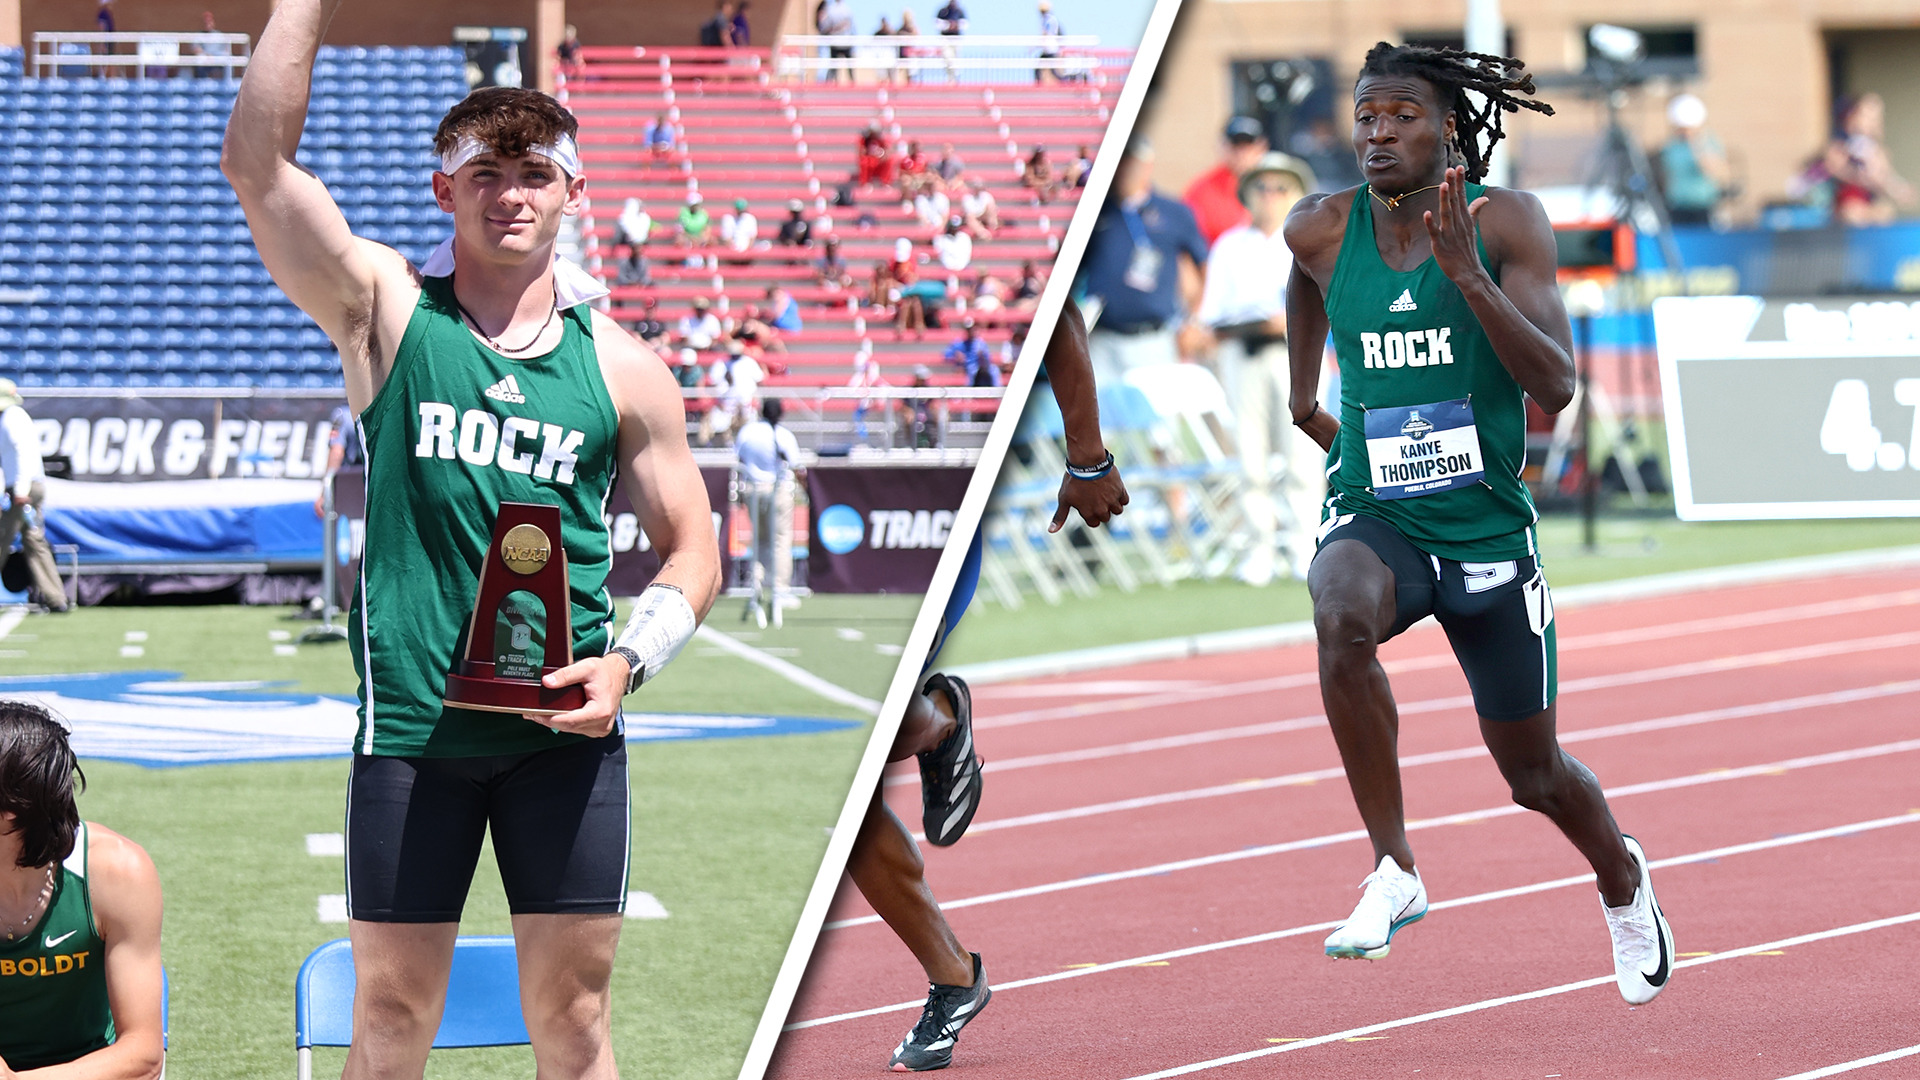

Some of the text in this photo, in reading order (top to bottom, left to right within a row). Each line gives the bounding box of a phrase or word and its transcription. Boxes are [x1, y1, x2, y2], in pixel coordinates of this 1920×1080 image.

[1389, 303, 1417, 312] adidas
[1360, 326, 1454, 369] ROCK
[485, 387, 525, 404] adidas
[163, 418, 207, 476] &
[415, 402, 586, 485] ROCK
[1400, 440, 1443, 459] KANYE
[1379, 452, 1472, 483] THOMPSON
[869, 509, 960, 549] TRAC
[504, 545, 548, 562] NCAA
[0, 951, 90, 977] BOLDT
